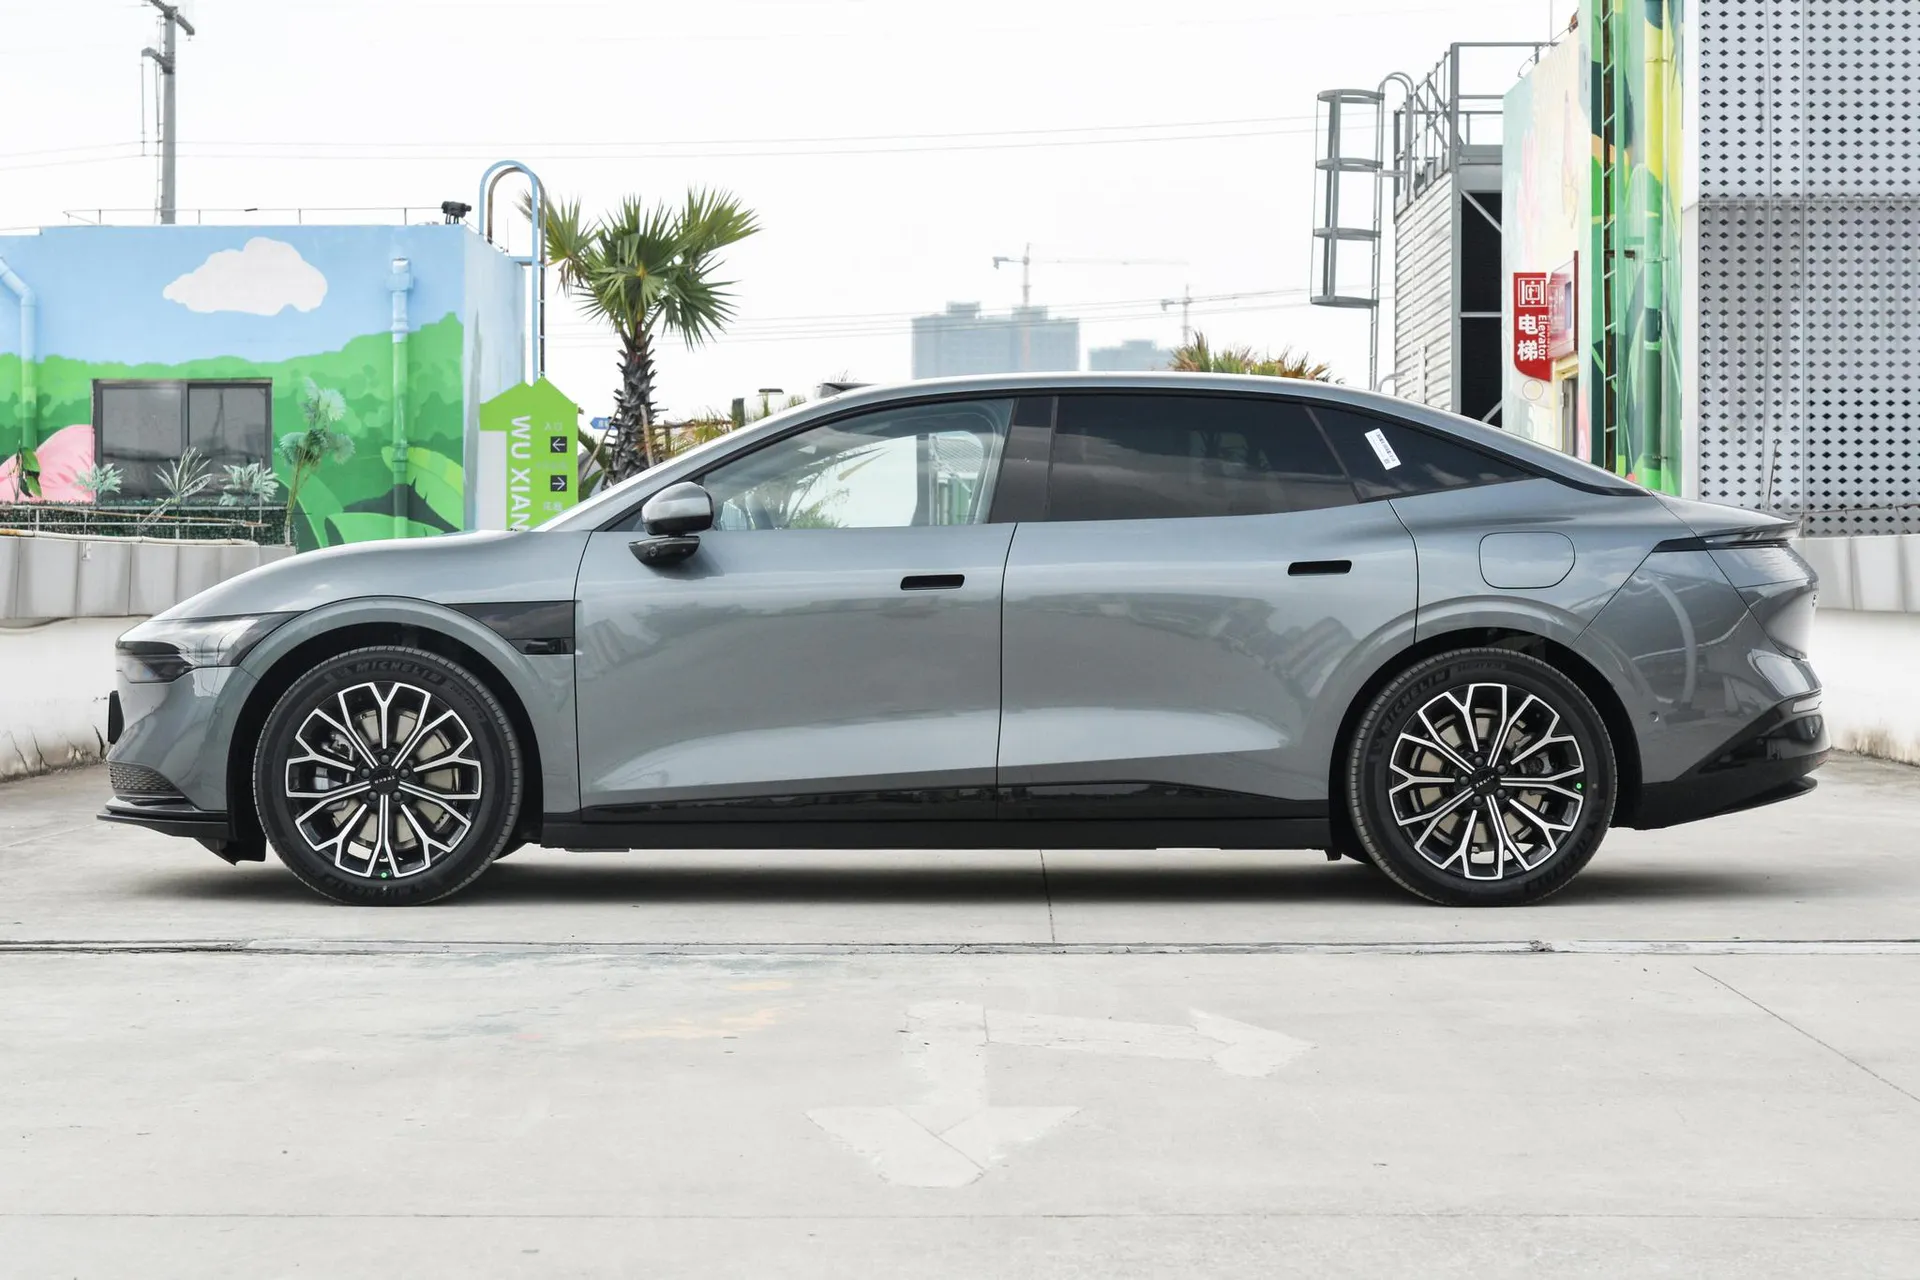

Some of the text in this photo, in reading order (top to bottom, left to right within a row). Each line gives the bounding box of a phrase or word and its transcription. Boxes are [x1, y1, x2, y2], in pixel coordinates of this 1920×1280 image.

[1517, 313, 1538, 361] 电梯
[1538, 314, 1548, 360] Elevator
[511, 415, 531, 459] WU
[355, 659, 443, 683] MICHELIN
[1382, 671, 1448, 733] MICHELIN
